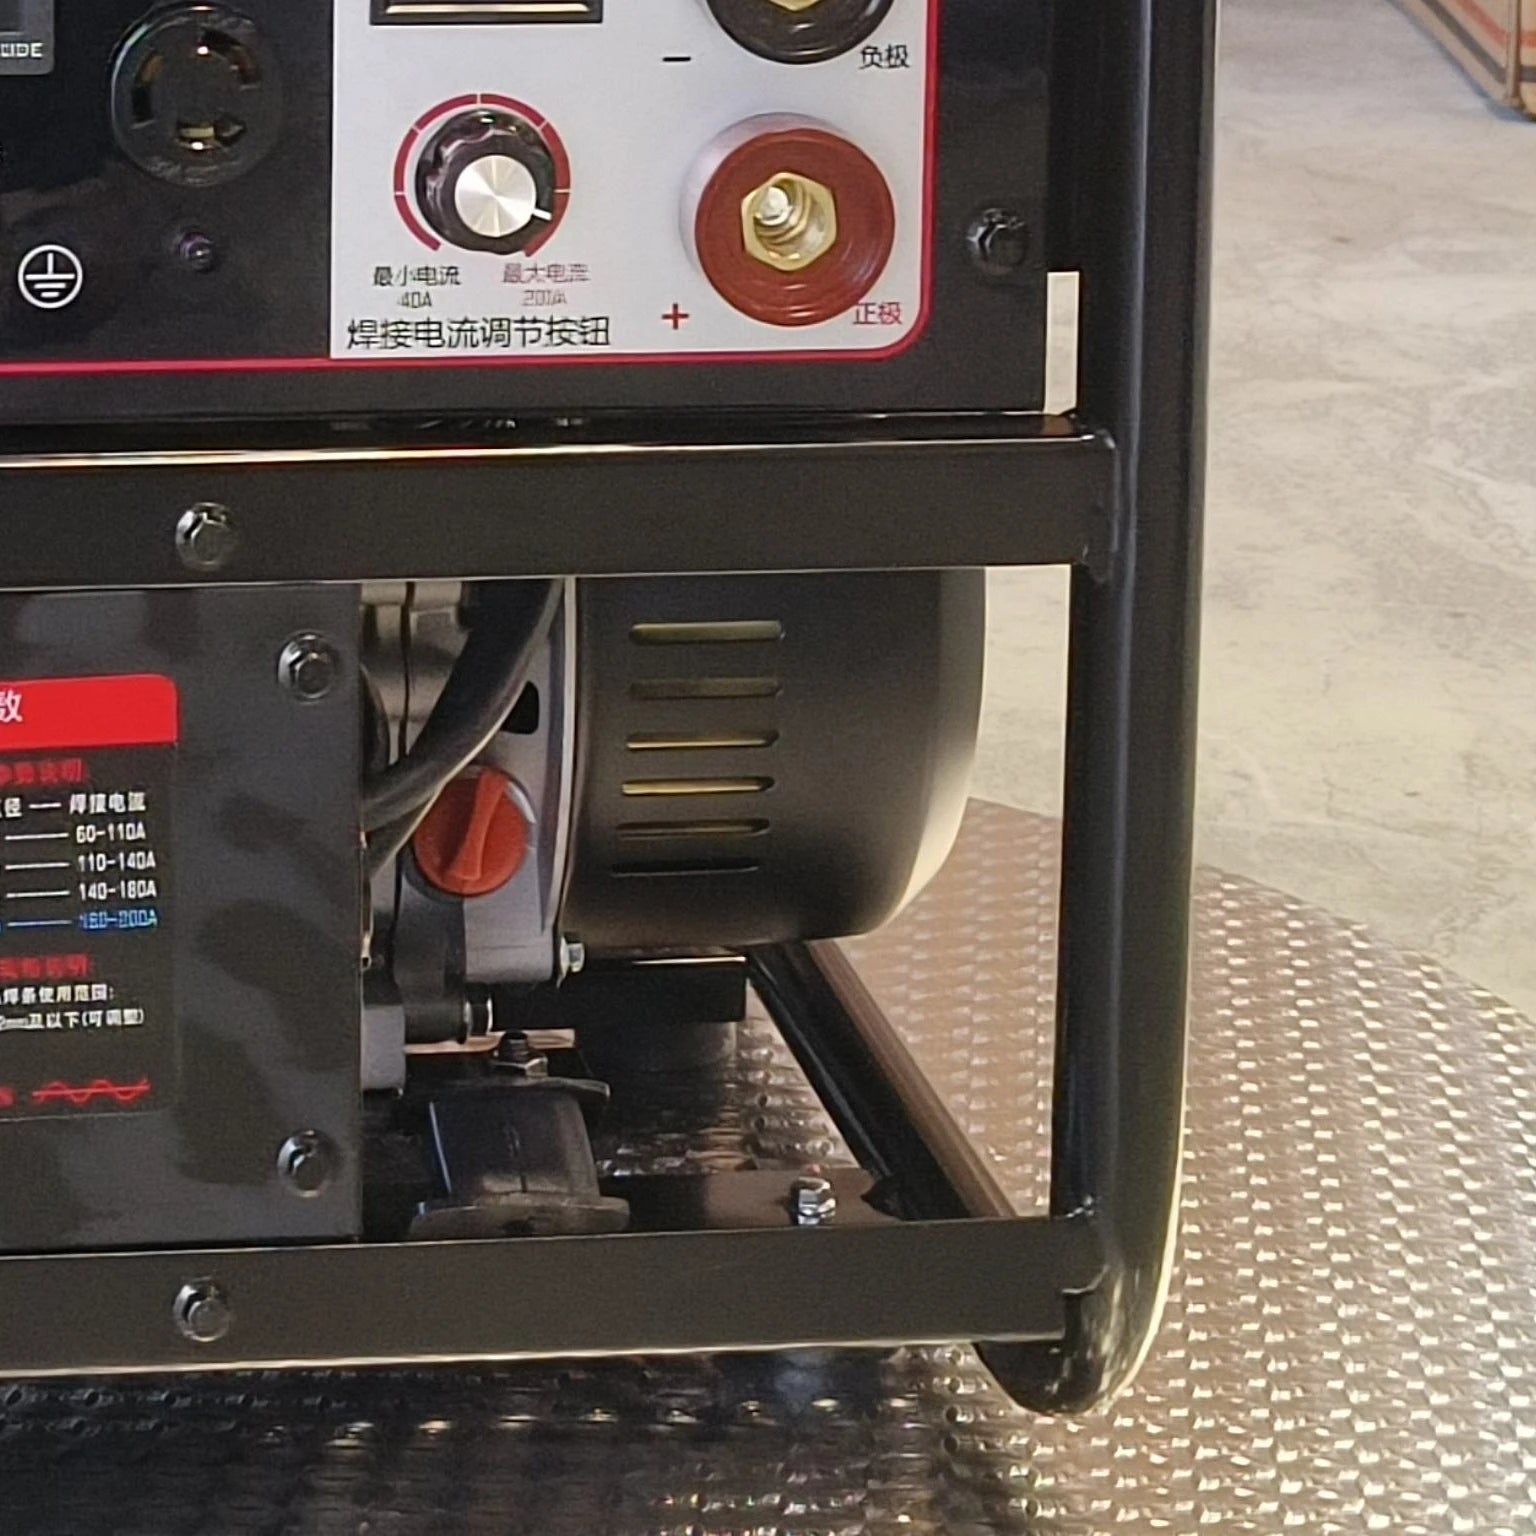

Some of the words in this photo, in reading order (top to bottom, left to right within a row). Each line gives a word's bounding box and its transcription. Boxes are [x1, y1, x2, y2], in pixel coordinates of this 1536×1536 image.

[859, 43, 909, 70] 负极
[373, 265, 462, 287] 最小电流
[853, 301, 902, 326] 正极
[78, 851, 156, 872] 110-140A
